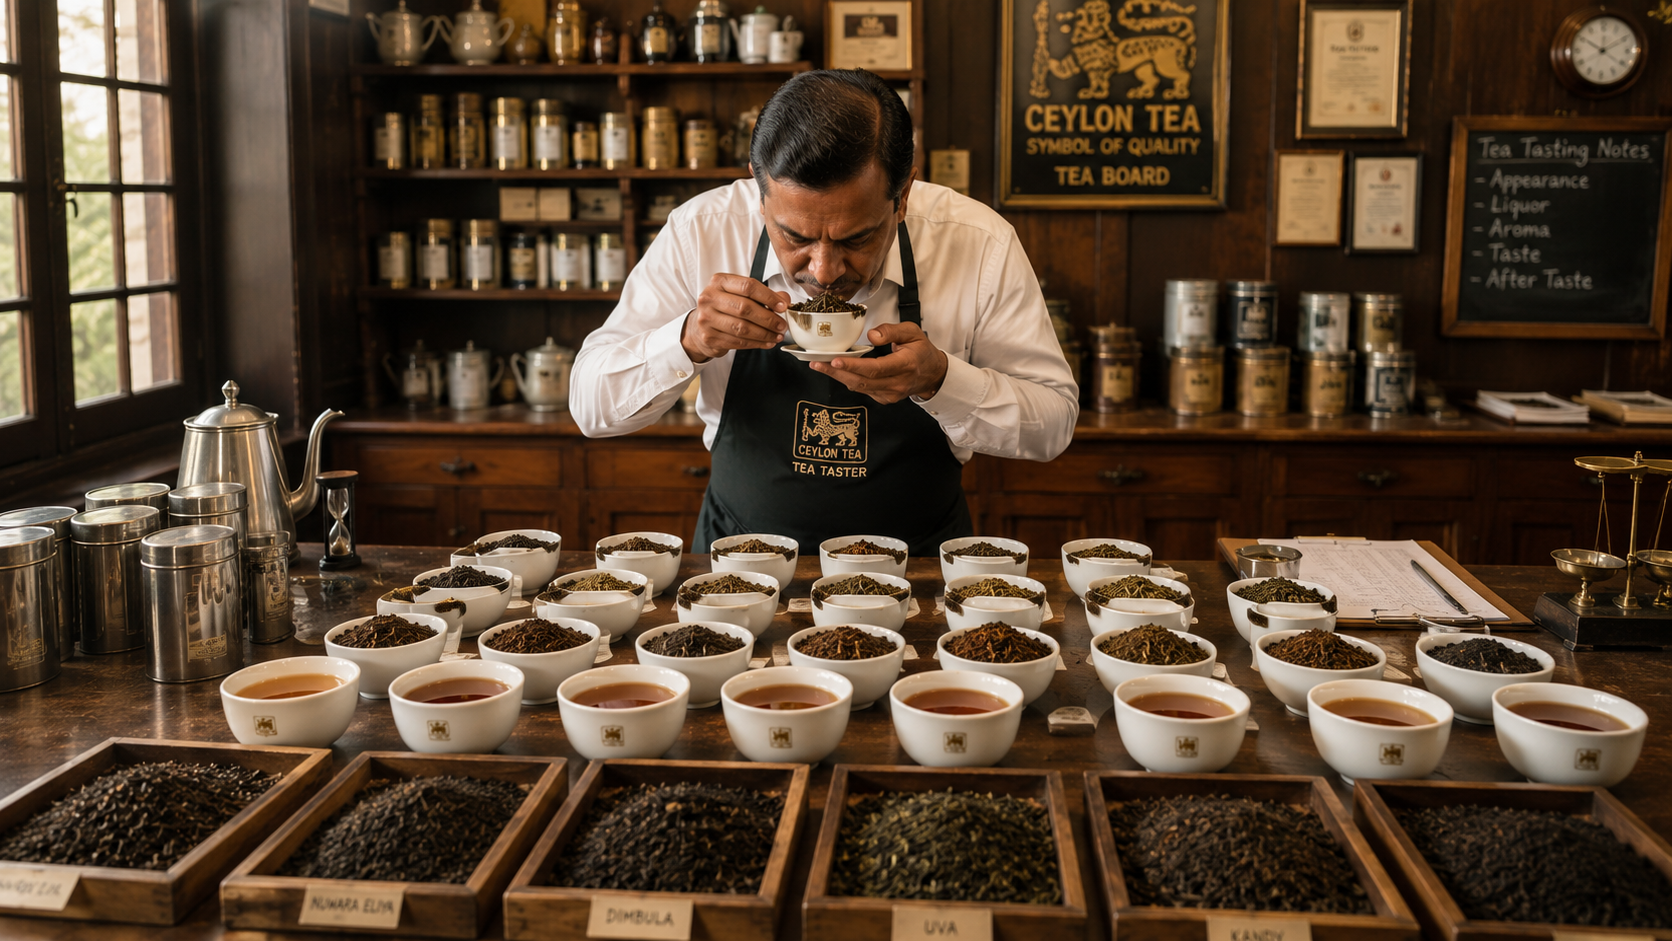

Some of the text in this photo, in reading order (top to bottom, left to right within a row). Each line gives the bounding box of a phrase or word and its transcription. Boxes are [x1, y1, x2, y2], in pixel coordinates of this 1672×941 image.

[1025, 104, 1201, 133] CEYLON TEA
[1026, 138, 1201, 157] SYMBOL OF QUALITY
[1477, 136, 1651, 168] Tea Tasting Notes
[1054, 166, 1170, 186] TEA BOARD
[1489, 168, 1590, 195] Appearance
[1491, 194, 1551, 221] Liquor
[1488, 217, 1551, 238] Aroma
[1488, 242, 1541, 263] Taste
[1485, 267, 1594, 291] After Taste
[798, 444, 862, 460] CEYLON TEA
[792, 461, 867, 478] TEA TASTER
[310, 896, 359, 912] NUWARA
[606, 907, 675, 927] DIMBULA
[923, 919, 959, 936] UVA
